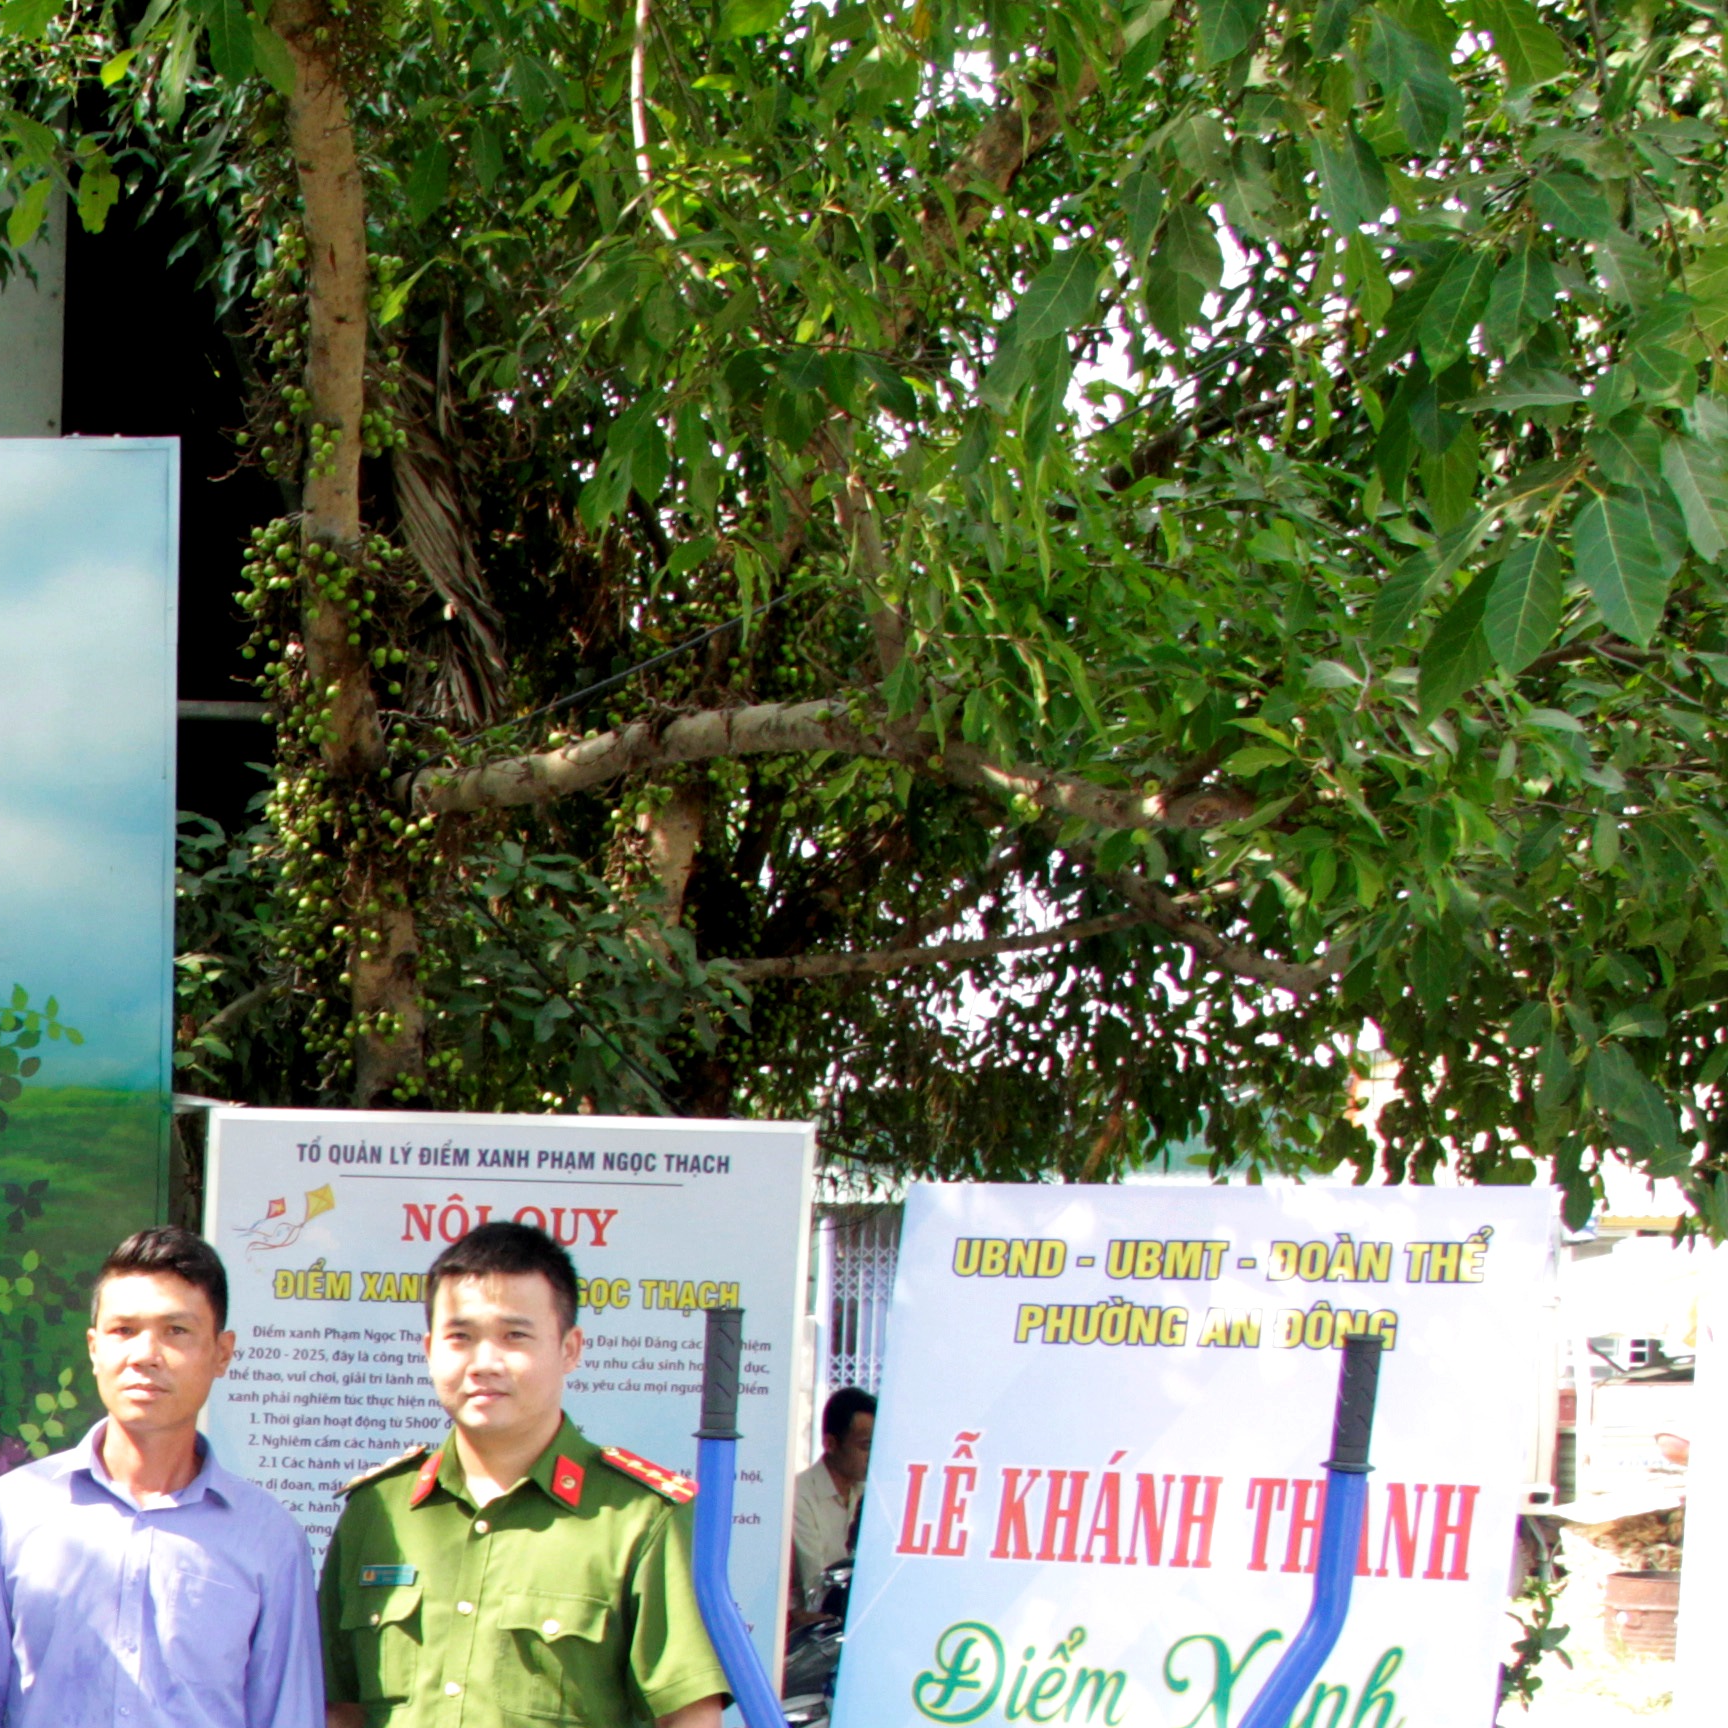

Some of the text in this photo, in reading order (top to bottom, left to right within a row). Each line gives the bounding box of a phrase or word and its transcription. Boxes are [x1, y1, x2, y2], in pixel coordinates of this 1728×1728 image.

[296, 1136, 730, 1178] TỔ QUẢN LÝ ĐIỂM XANH PHẠM NGỌC THẠCH
[952, 1225, 1494, 1283] UBND UBMT ĐOÀN THỂ
[274, 1258, 352, 1301] ĐIỂM
[360, 1272, 430, 1302] XAN
[641, 1280, 740, 1317] THẠCH
[1015, 1296, 1399, 1350] PHƯỜNG AN ĐÔNG
[289, 1327, 320, 1340] xanh
[324, 1327, 360, 1343] Phạm
[364, 1329, 396, 1344] Ngọc
[597, 1335, 618, 1350] Đại
[621, 1335, 641, 1349] hội
[248, 1347, 281, 1360] 2020
[293, 1348, 329, 1363] 2025,
[332, 1349, 354, 1365] đây
[373, 1351, 403, 1366] công
[603, 1359, 628, 1370] nhu
[658, 1359, 684, 1372] sinh
[229, 1365, 250, 1381] thể
[252, 1368, 284, 1383] thao,
[287, 1370, 306, 1382] vui
[385, 1371, 414, 1385] lành
[644, 1380, 667, 1395] mọi
[228, 1391, 259, 1403] xanh
[293, 1392, 341, 1407] nghiêm
[397, 1395, 425, 1409] hiện
[249, 1412, 260, 1424] 1.
[293, 1414, 321, 1428] gian
[323, 1414, 352, 1429] hoạt
[355, 1414, 386, 1430] động
[248, 1434, 260, 1446] 2.
[262, 1433, 312, 1449] Nghiêm
[344, 1436, 365, 1449] các
[368, 1436, 400, 1450] hành
[258, 1455, 277, 1468] 2.1
[281, 1455, 305, 1469] Các
[308, 1456, 340, 1470] hành
[308, 1500, 341, 1513] hành
[896, 1431, 985, 1557] LỄ
[989, 1450, 1223, 1569] KHÁNH
[910, 1621, 1128, 1726] Điểm
